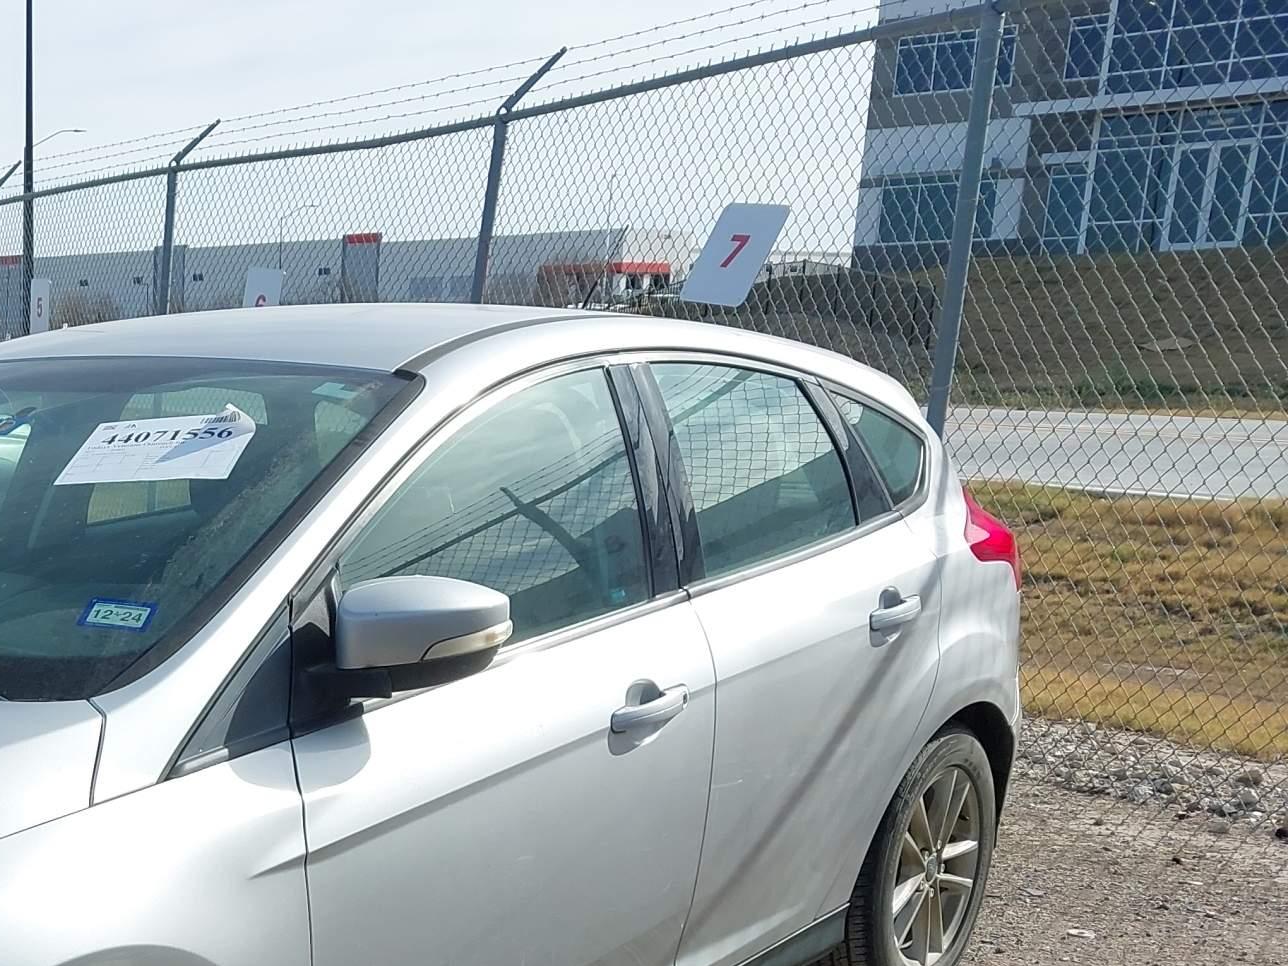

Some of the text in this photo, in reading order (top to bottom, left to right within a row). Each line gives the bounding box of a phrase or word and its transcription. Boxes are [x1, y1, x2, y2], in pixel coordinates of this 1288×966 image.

[720, 234, 751, 268] 7
[36, 297, 44, 318] 5
[101, 426, 234, 446] 44071556
[93, 608, 143, 623] 12 24
